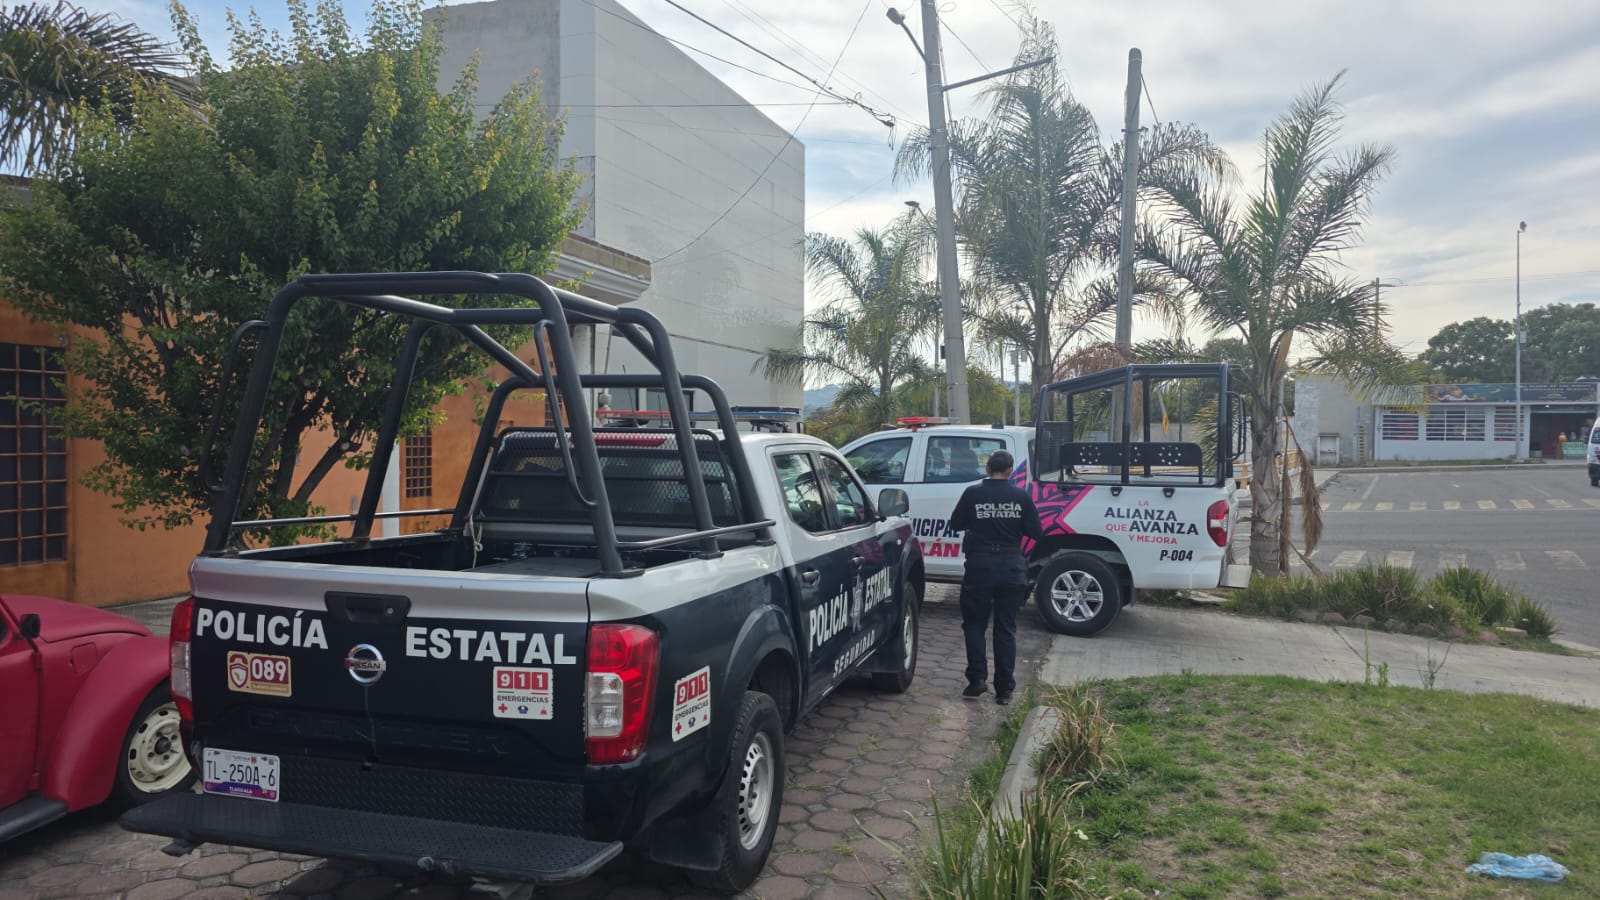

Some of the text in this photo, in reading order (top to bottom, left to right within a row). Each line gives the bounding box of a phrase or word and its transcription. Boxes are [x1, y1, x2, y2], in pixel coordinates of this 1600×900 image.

[975, 502, 1022, 512] POLICÍA
[1104, 507, 1177, 521] ALIANZA
[976, 511, 1022, 519] ESTATAL
[1105, 520, 1199, 535] QUE AVANZA
[1136, 535, 1178, 545] MEJORA
[1159, 549, 1193, 562] P-004
[809, 566, 892, 654] POLICÍA ESTATAL
[196, 608, 577, 665] POLICÍA ESTATAL
[252, 658, 287, 682] 089
[497, 695, 549, 704] EMERGENCIAS
[206, 759, 276, 787] TL-250A-6
